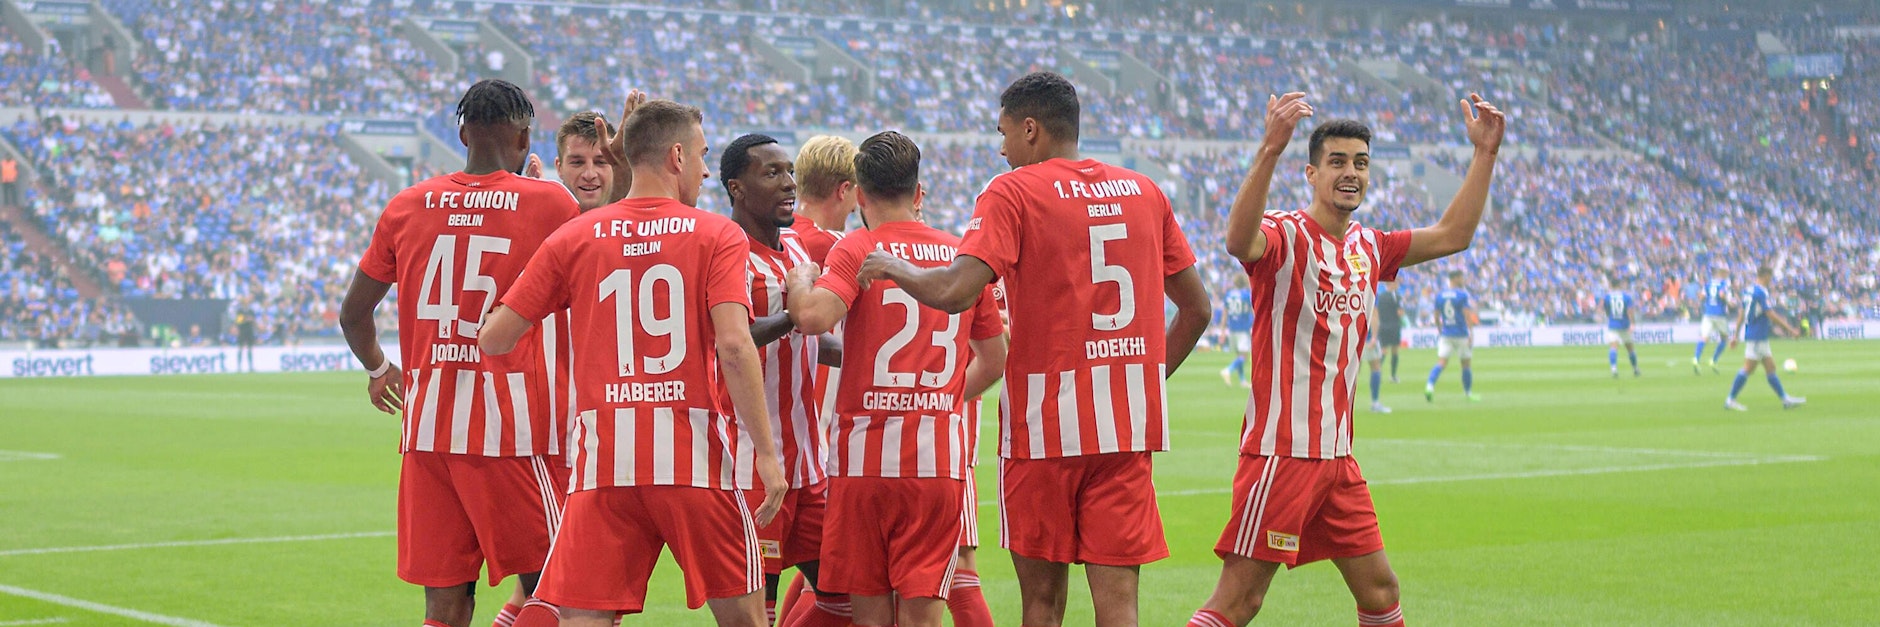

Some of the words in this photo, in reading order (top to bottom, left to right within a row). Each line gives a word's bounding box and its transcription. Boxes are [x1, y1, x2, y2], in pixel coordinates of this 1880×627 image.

[1054, 180, 1070, 199] 1.
[1070, 180, 1091, 198] FC
[1089, 179, 1142, 199] UNION
[424, 191, 435, 209] 1.
[440, 191, 461, 209] FC
[463, 190, 519, 211] UNION
[1087, 203, 1122, 218] BERLIN
[448, 214, 484, 227] BERLIN
[593, 222, 607, 238] 1.
[611, 220, 633, 237] FC
[637, 217, 697, 237] UNION
[623, 241, 662, 257] BERLIN
[889, 242, 911, 260] FC
[911, 243, 958, 262] UNION
[417, 234, 512, 339] 45
[1088, 223, 1136, 331] 5
[598, 263, 687, 378] 19
[1827, 324, 1865, 338] sievert
[873, 287, 961, 389] 23
[1488, 329, 1533, 345] sievert
[1562, 328, 1605, 345] sievert
[1633, 327, 1674, 343] sievert
[1085, 337, 1146, 360] DOEKHI
[12, 353, 95, 376] sievert
[149, 352, 226, 373] sievert
[280, 350, 353, 371] sievert
[605, 380, 686, 403] HABERER
